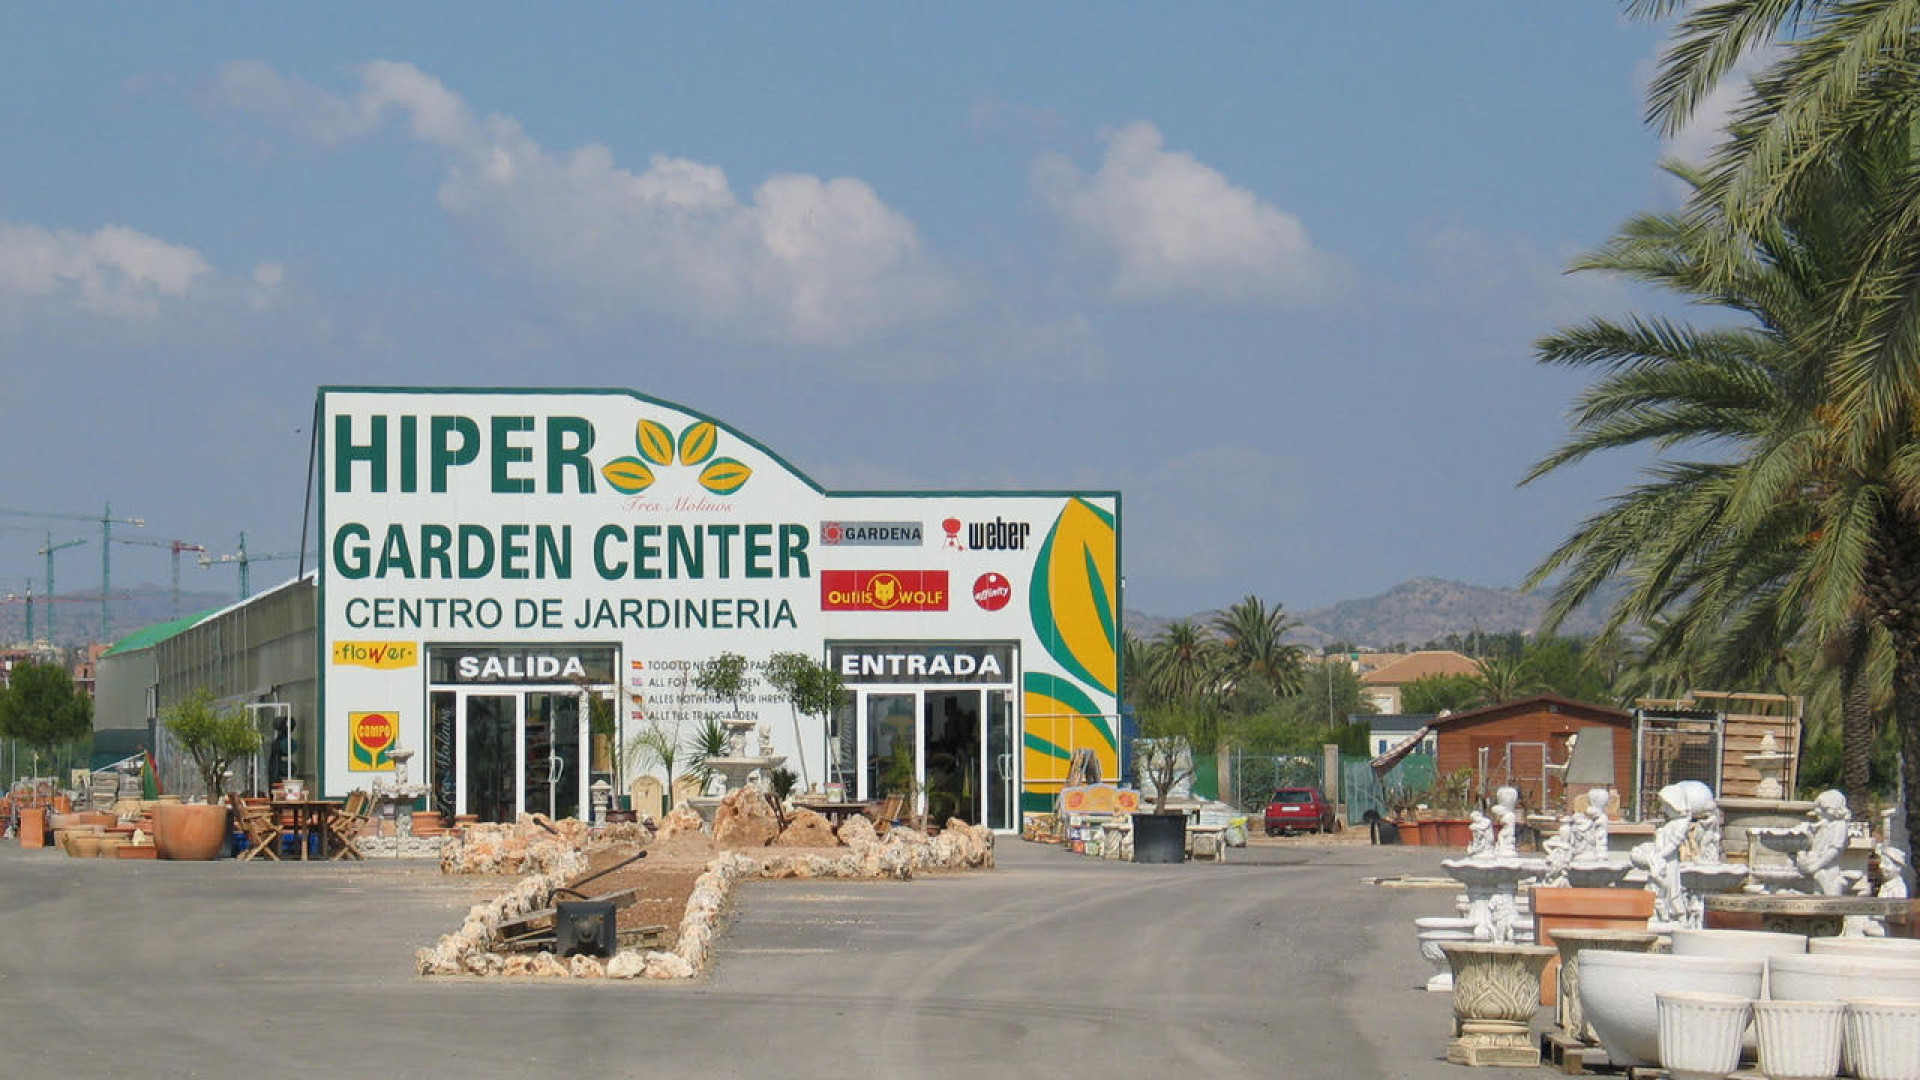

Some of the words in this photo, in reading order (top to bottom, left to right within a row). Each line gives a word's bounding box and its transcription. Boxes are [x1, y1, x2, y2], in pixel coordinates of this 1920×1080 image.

[334, 415, 597, 495] HIPER
[624, 495, 661, 512] Tres
[672, 495, 733, 512] Molinos
[845, 527, 922, 541] GARDENA
[968, 515, 1030, 551] weber
[333, 522, 572, 581] GARDEN
[593, 523, 811, 581] CENTER
[827, 590, 873, 604] Outils
[899, 590, 943, 604] WOLF
[974, 586, 1008, 602] affinity
[345, 597, 503, 629] CENTRO
[515, 598, 563, 629] DE
[574, 598, 798, 629] JARDINERIA
[342, 643, 406, 665] flower
[842, 654, 1002, 676] ENTRADA
[459, 656, 586, 678] SALIDA
[359, 724, 392, 739] COMPO
